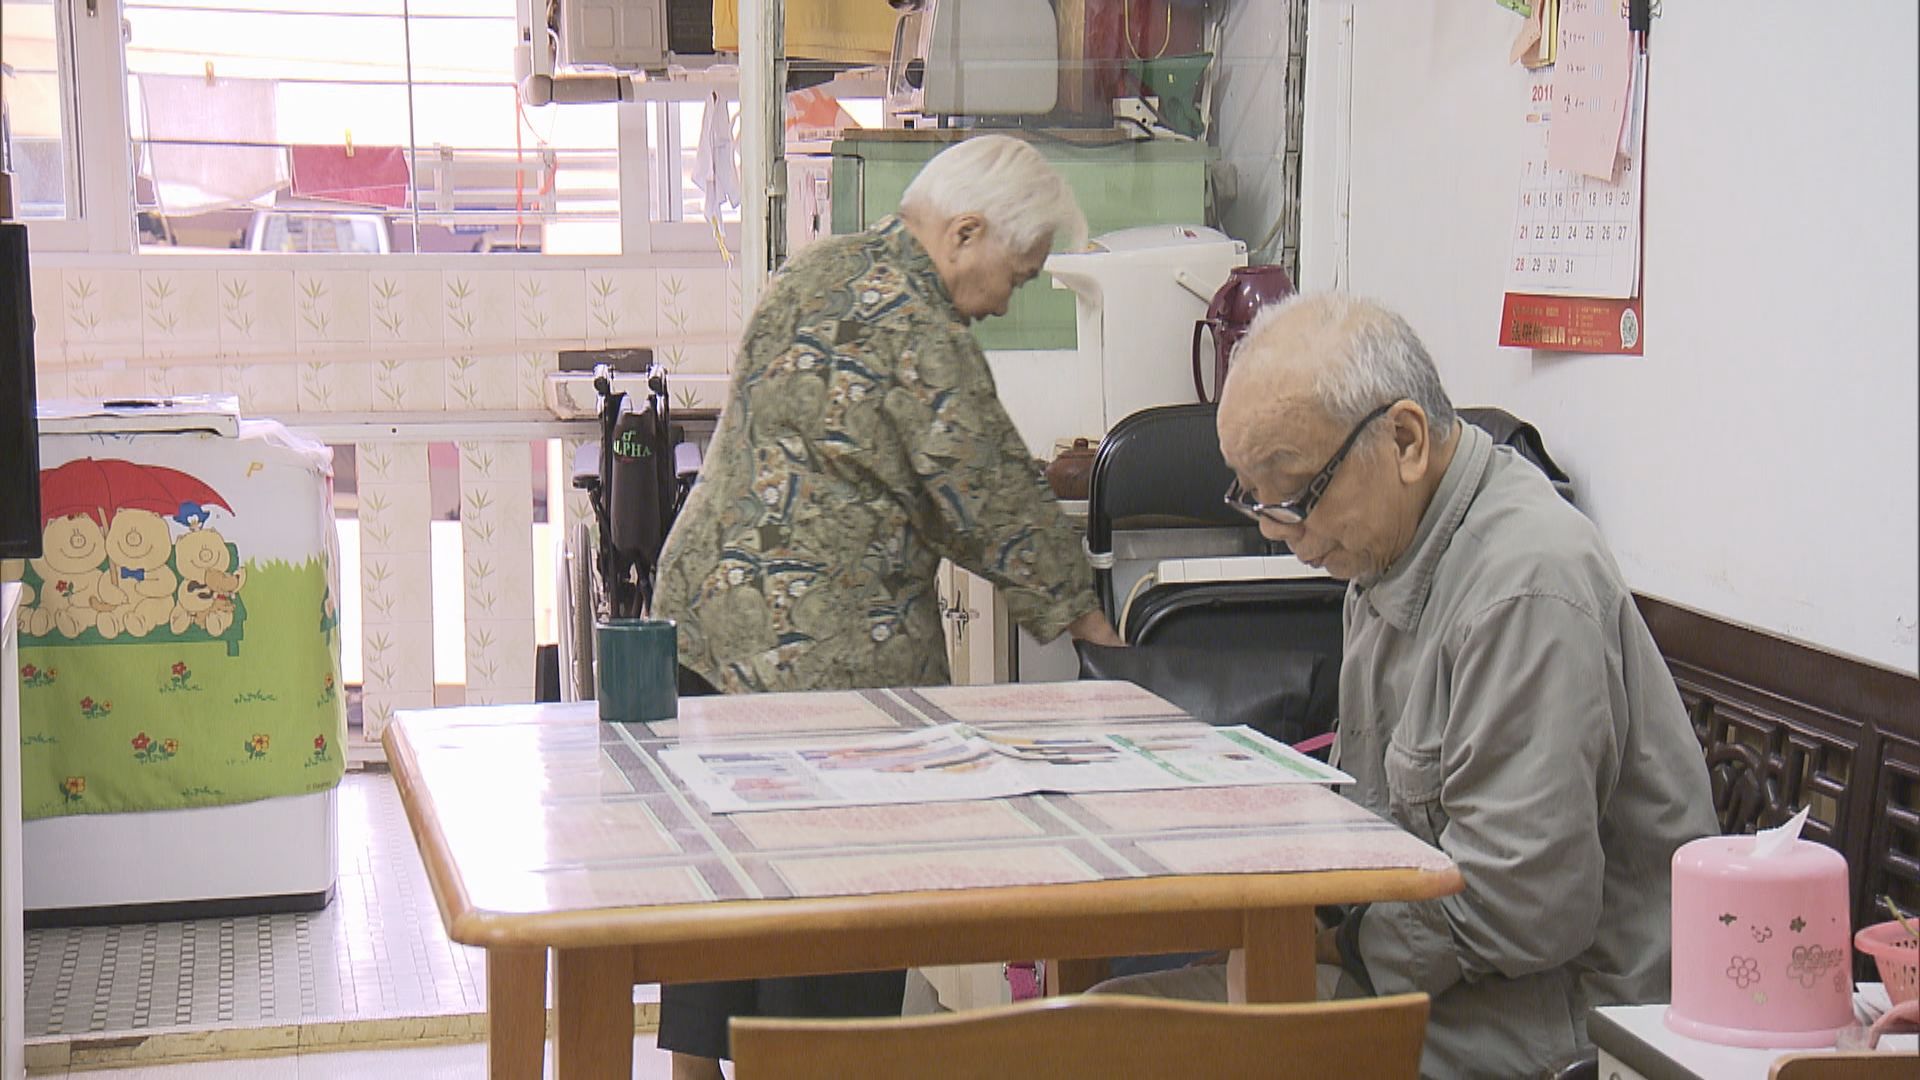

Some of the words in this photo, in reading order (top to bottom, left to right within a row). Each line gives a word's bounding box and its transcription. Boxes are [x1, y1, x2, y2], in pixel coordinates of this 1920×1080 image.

[1523, 192, 1531, 206] 14
[1539, 191, 1547, 207] 15
[1555, 191, 1563, 207] 16
[1571, 191, 1580, 206] 17
[1589, 191, 1597, 206] 18
[1605, 191, 1613, 206] 19
[1620, 191, 1630, 206] 20
[1519, 225, 1528, 240] 21
[1535, 225, 1544, 240] 22
[1551, 225, 1560, 240] 23
[1568, 225, 1577, 240] 24
[1585, 225, 1594, 240] 25
[1602, 225, 1611, 240] 26
[1618, 225, 1627, 240] 27
[1515, 257, 1525, 272] 28
[1532, 257, 1541, 272] 29
[1548, 257, 1557, 273] 30
[1566, 258, 1574, 273] 31
